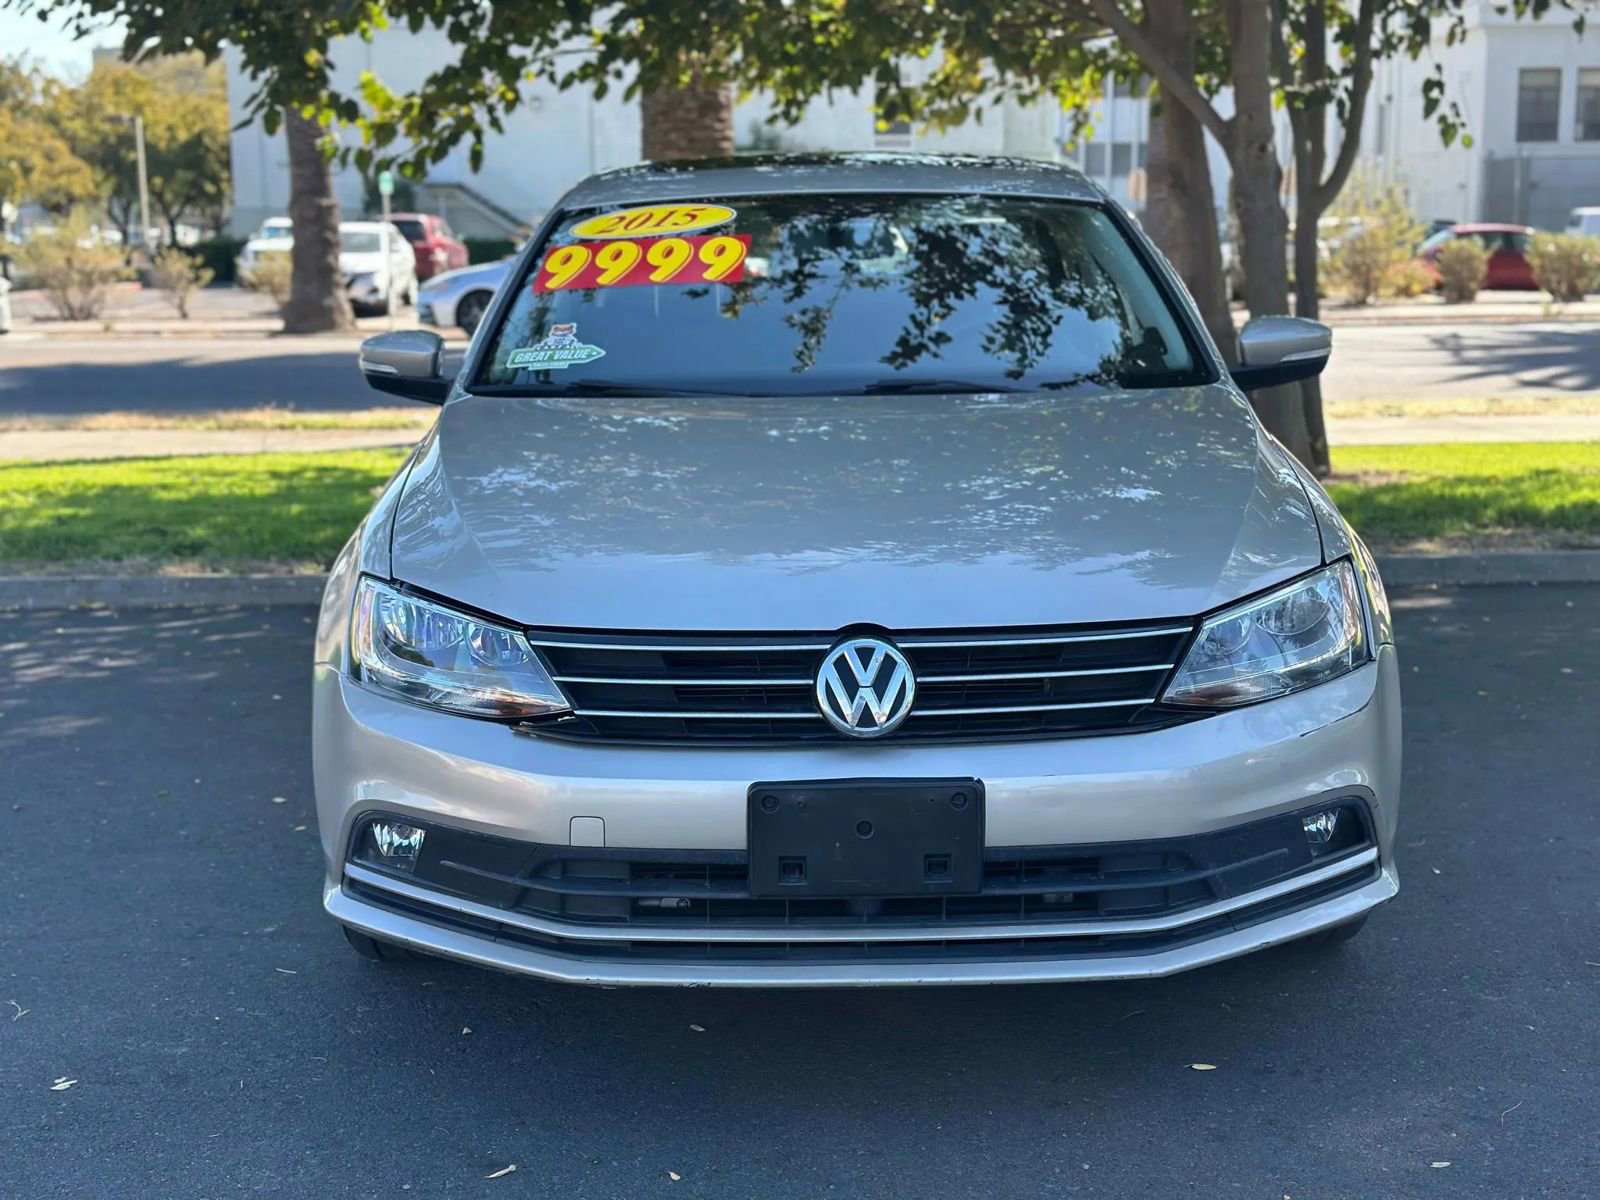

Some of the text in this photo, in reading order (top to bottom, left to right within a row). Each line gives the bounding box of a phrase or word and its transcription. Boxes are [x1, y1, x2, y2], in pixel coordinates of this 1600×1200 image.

[597, 208, 707, 234] 2015
[545, 236, 747, 289] 9999
[514, 349, 592, 363] GREAT VALUE
[817, 638, 916, 738] VW
